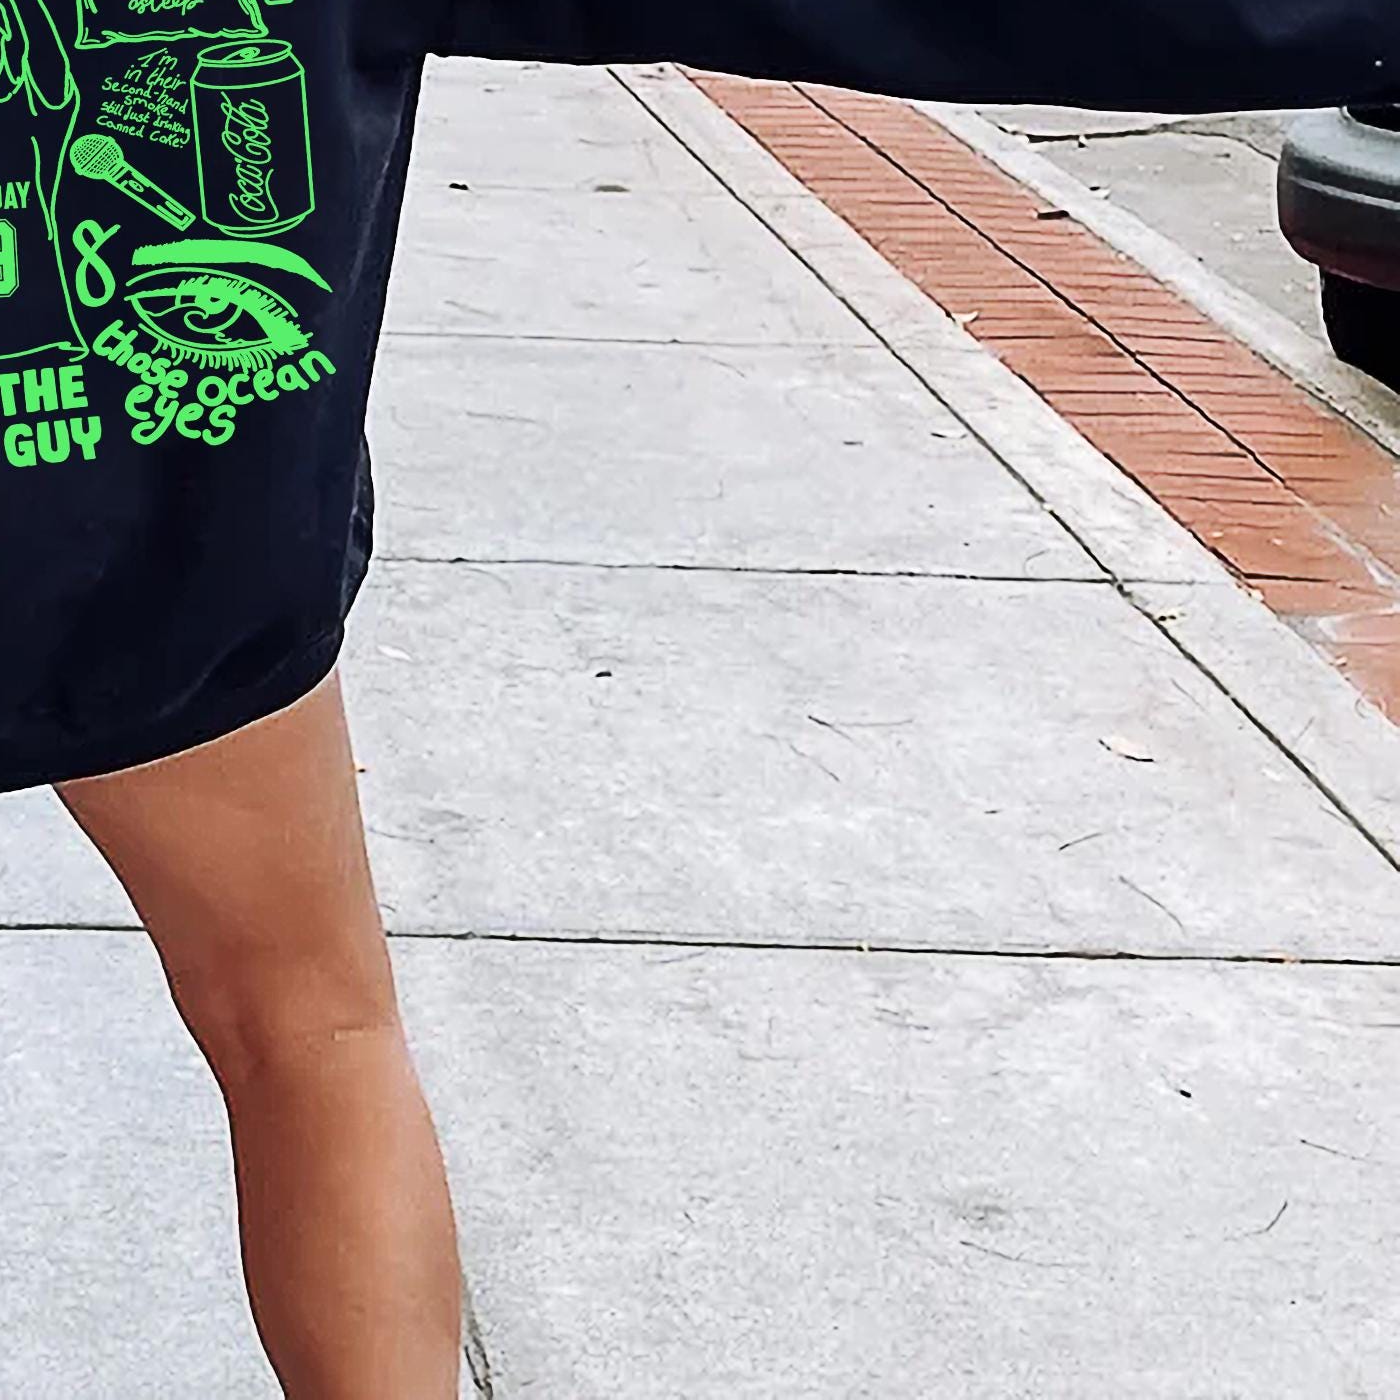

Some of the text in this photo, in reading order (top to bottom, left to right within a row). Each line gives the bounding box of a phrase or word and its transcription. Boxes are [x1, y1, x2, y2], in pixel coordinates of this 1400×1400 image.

[124, 64, 187, 91] in their
[137, 47, 178, 70] I'm
[100, 100, 124, 116] still
[196, 350, 337, 409] ocean
[124, 383, 236, 446] eyes
[3, 416, 102, 468] GUY
